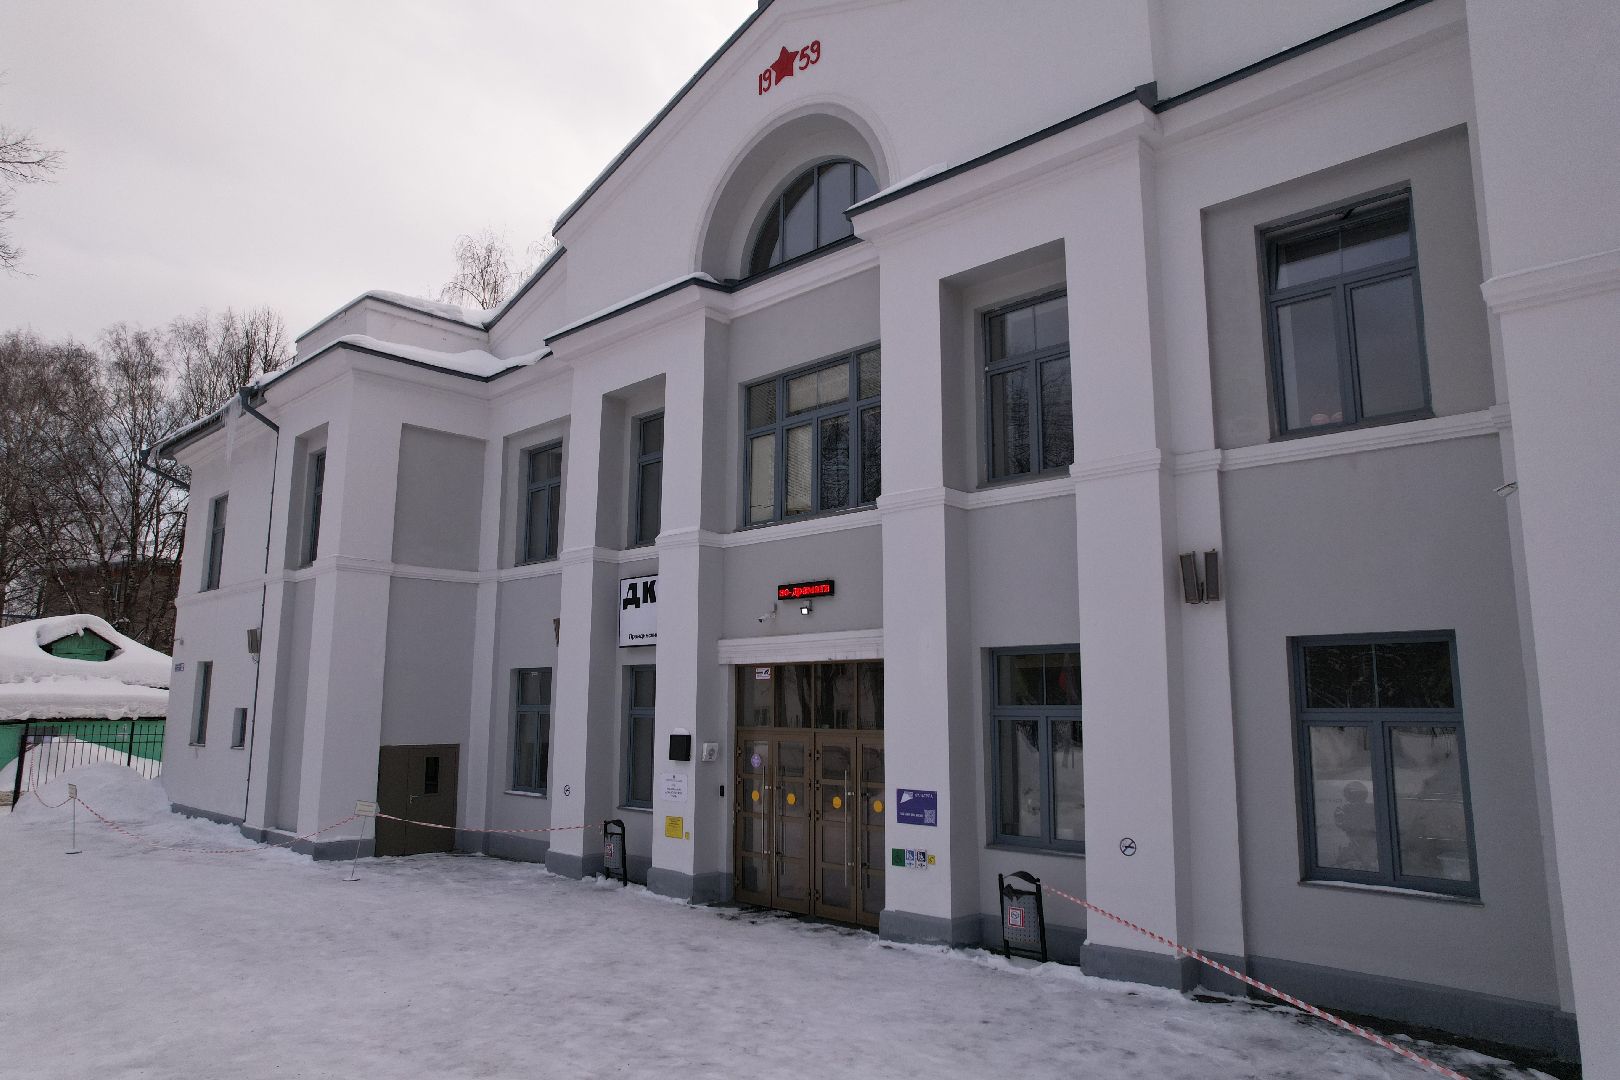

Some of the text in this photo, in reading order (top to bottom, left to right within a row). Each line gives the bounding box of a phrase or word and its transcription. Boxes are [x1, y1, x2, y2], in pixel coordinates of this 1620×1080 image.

[758, 40, 821, 96] 19 59
[622, 579, 657, 611] ДК
